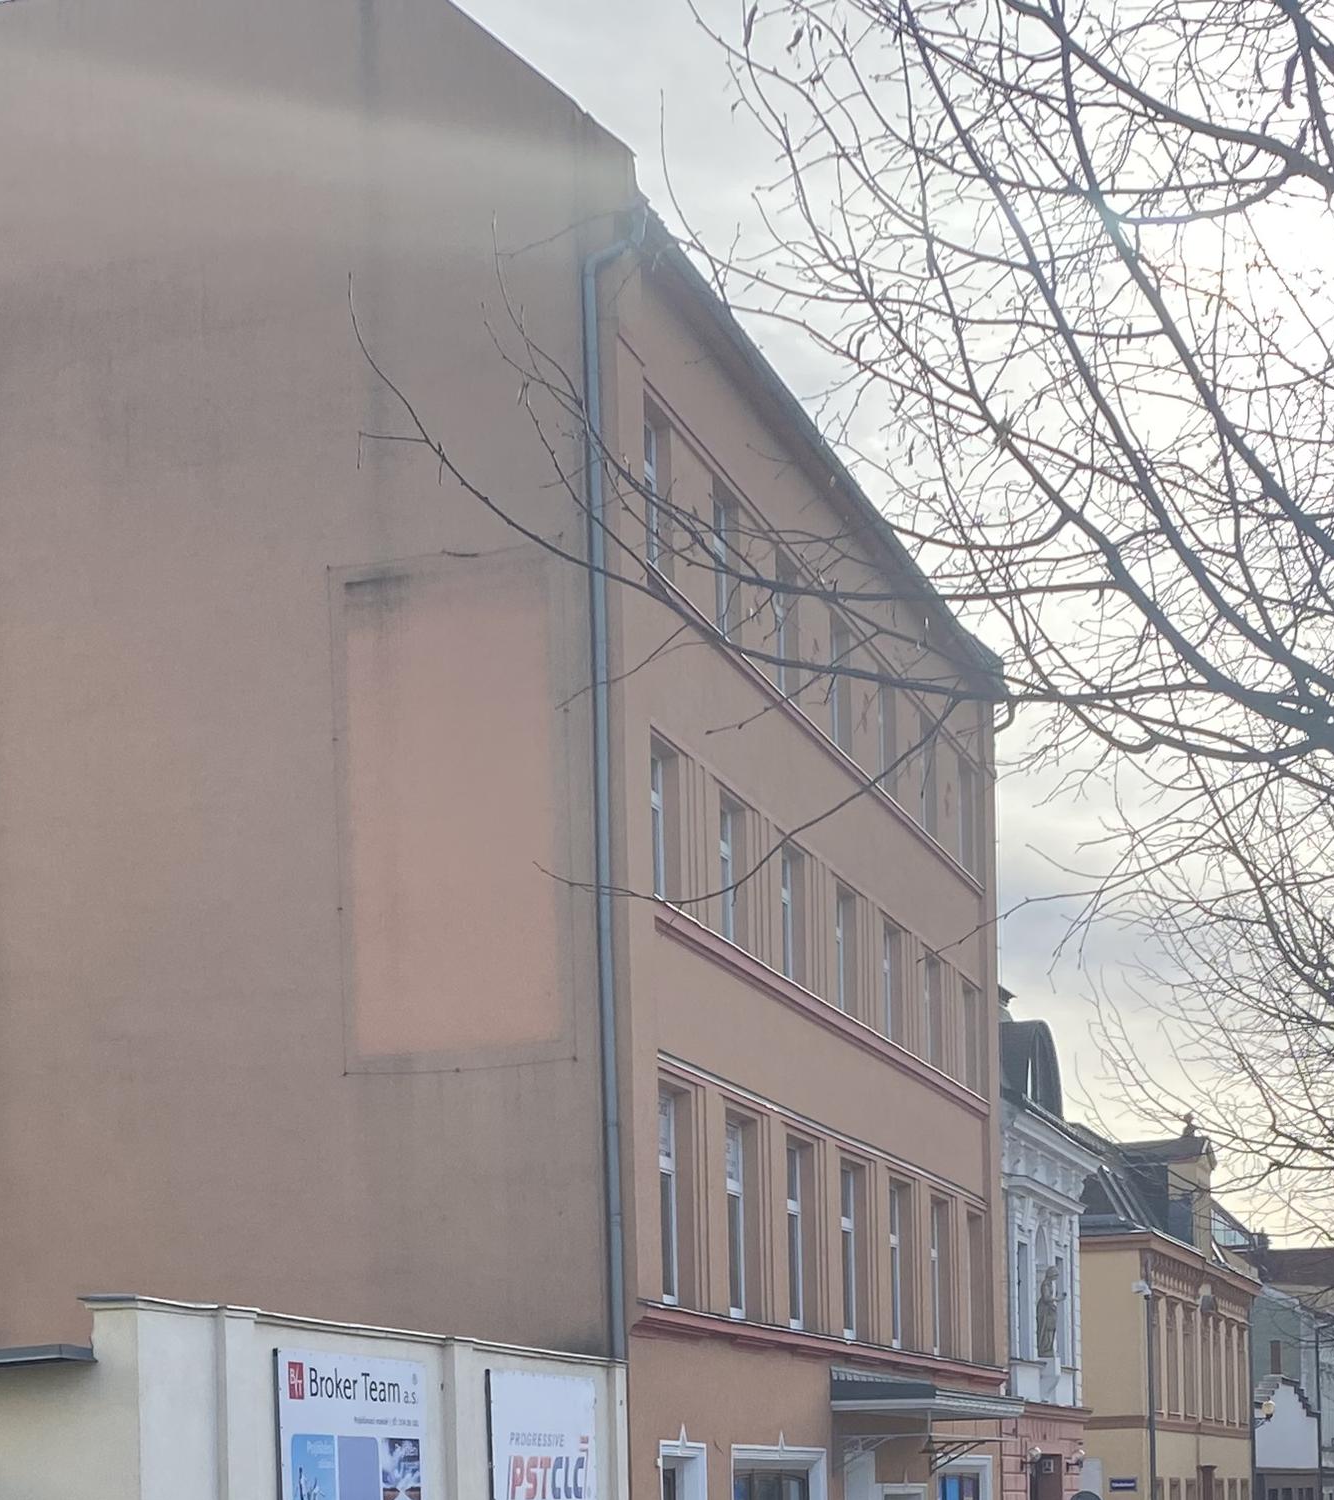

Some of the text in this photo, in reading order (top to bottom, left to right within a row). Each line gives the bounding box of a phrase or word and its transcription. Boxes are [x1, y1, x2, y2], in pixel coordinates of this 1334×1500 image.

[309, 1367, 419, 1404] Broker Team a.s.
[509, 1432, 565, 1447] PROGRESSIVE
